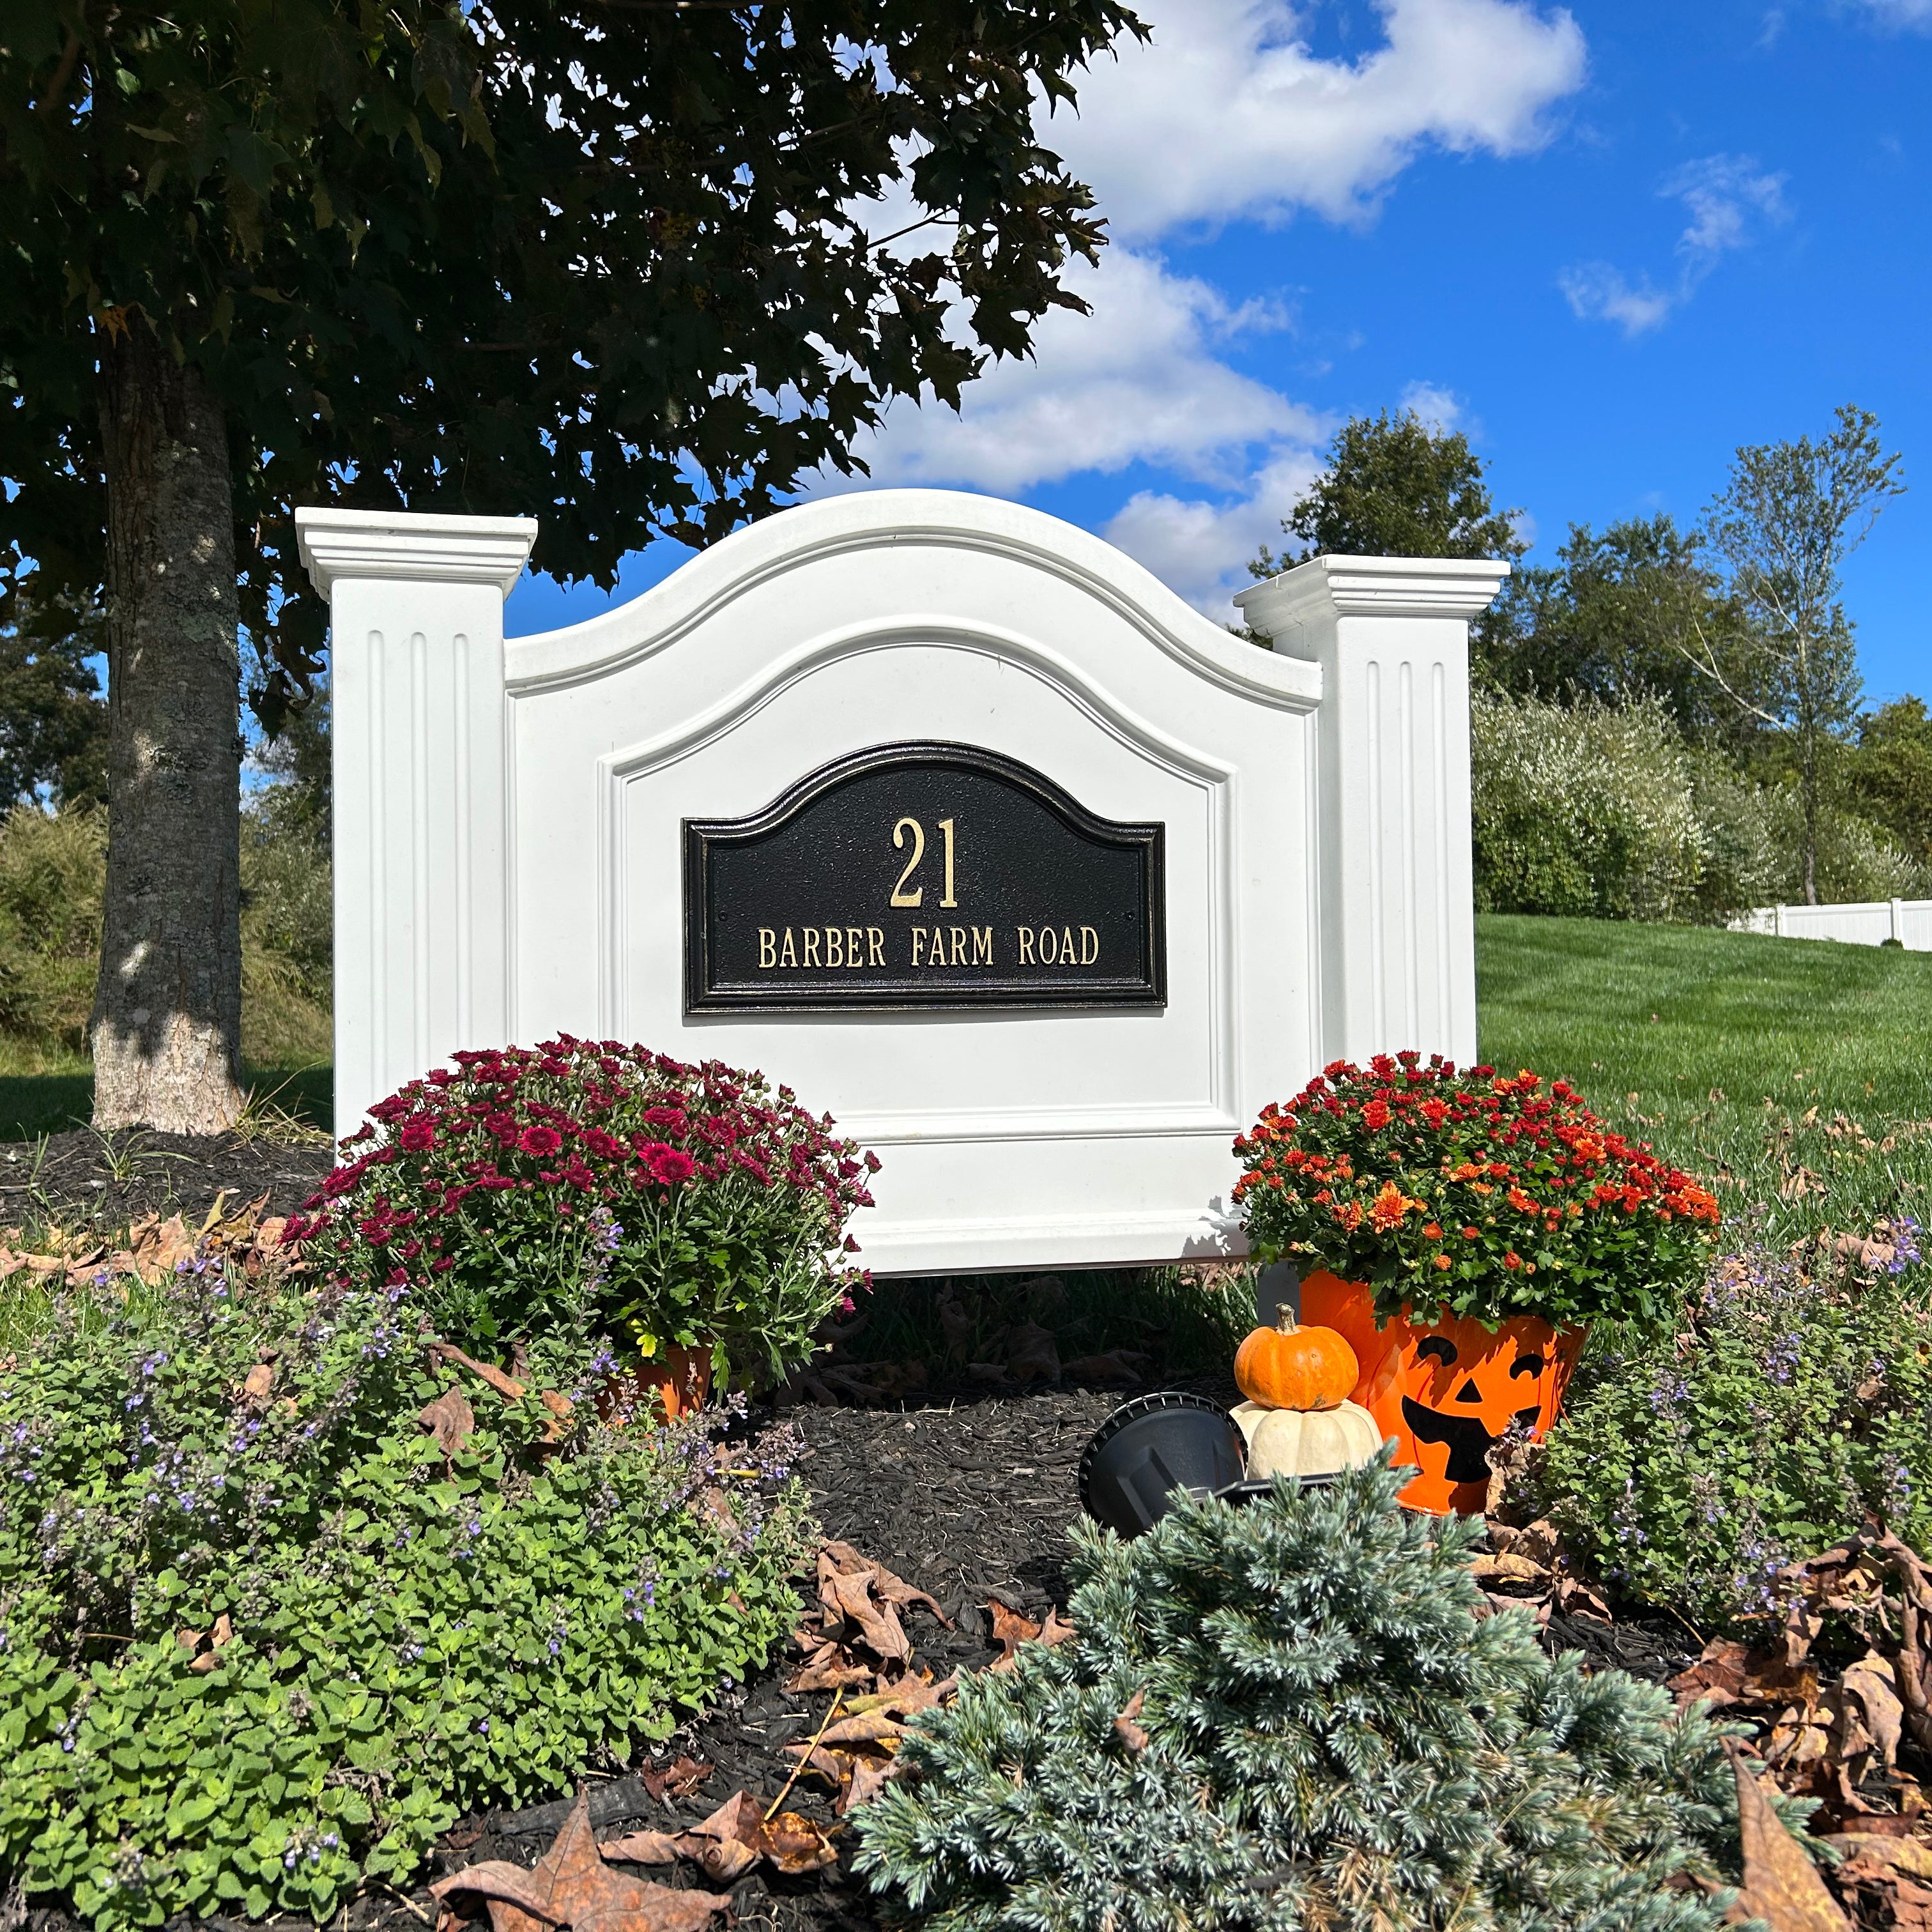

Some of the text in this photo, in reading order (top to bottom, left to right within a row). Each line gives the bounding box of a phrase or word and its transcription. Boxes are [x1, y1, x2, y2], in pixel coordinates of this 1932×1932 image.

[890, 817, 958, 908] 21
[758, 926, 1099, 968] BARBER FARM ROAD
